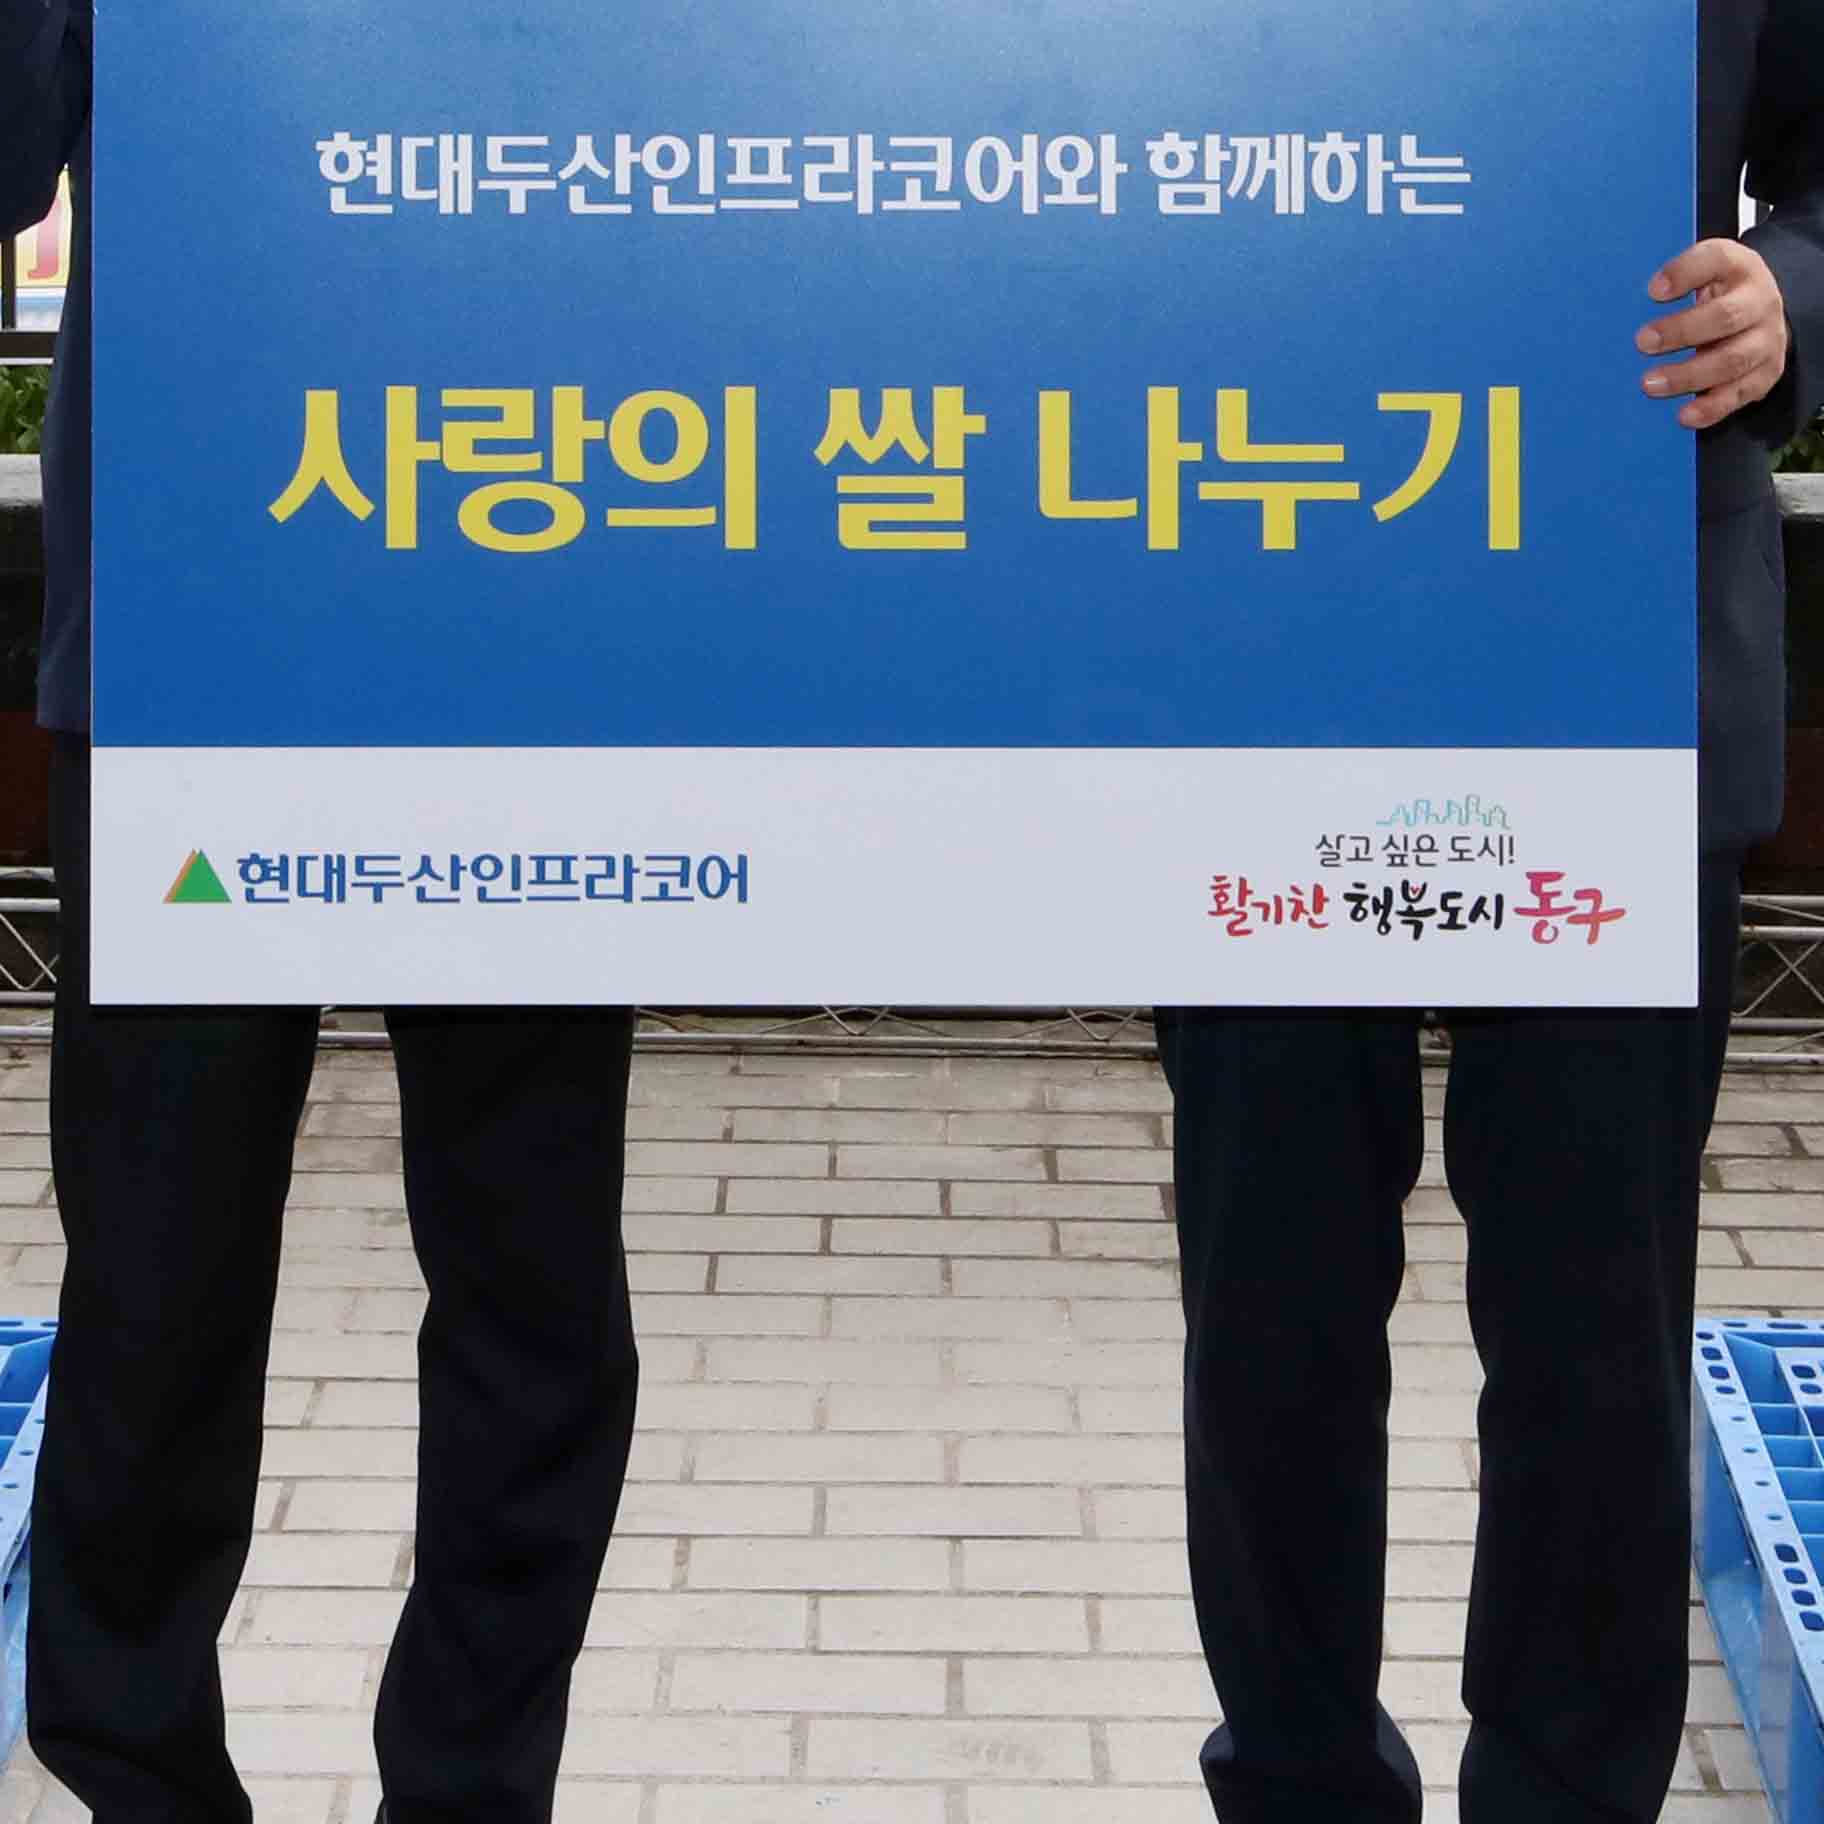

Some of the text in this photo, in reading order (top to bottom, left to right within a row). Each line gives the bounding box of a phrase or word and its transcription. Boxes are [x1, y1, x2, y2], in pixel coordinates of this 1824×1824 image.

[314, 130, 1472, 216] 현대두산인프라코어와 함께하는
[268, 384, 1523, 553] 사랑의 쌀 나누기
[234, 850, 750, 907] 현대두산인프라코어
[1313, 833, 1516, 868] 살고 싶은 도시!
[1204, 869, 1626, 947] 활기찬 행복도시 동구
